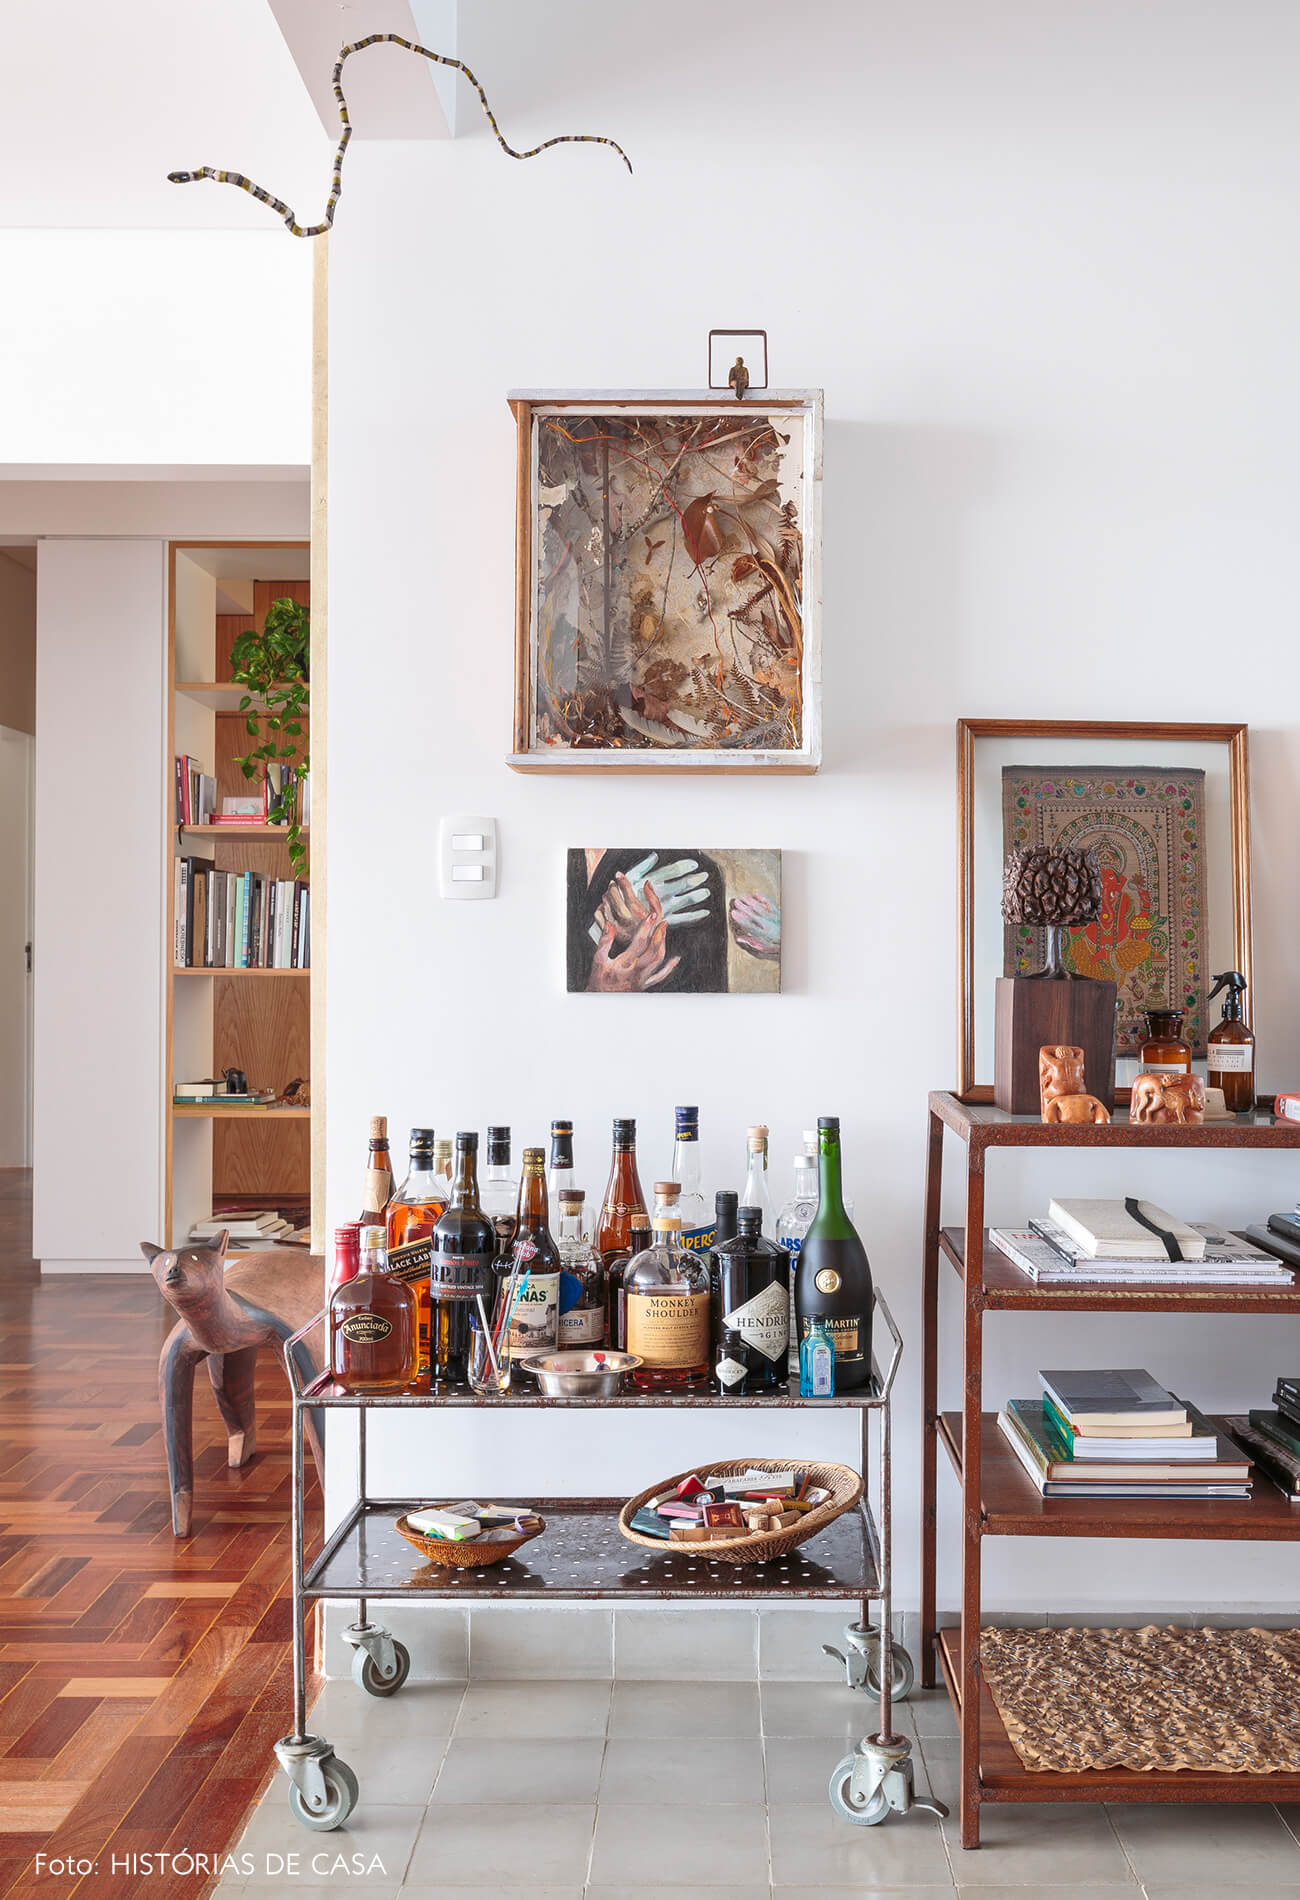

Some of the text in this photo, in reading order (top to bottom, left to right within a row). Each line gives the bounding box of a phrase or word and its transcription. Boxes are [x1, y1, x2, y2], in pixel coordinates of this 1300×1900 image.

[780, 1236, 805, 1252] ABS
[650, 1298, 696, 1308] MONKEY
[825, 1318, 859, 1329] MARTIN
